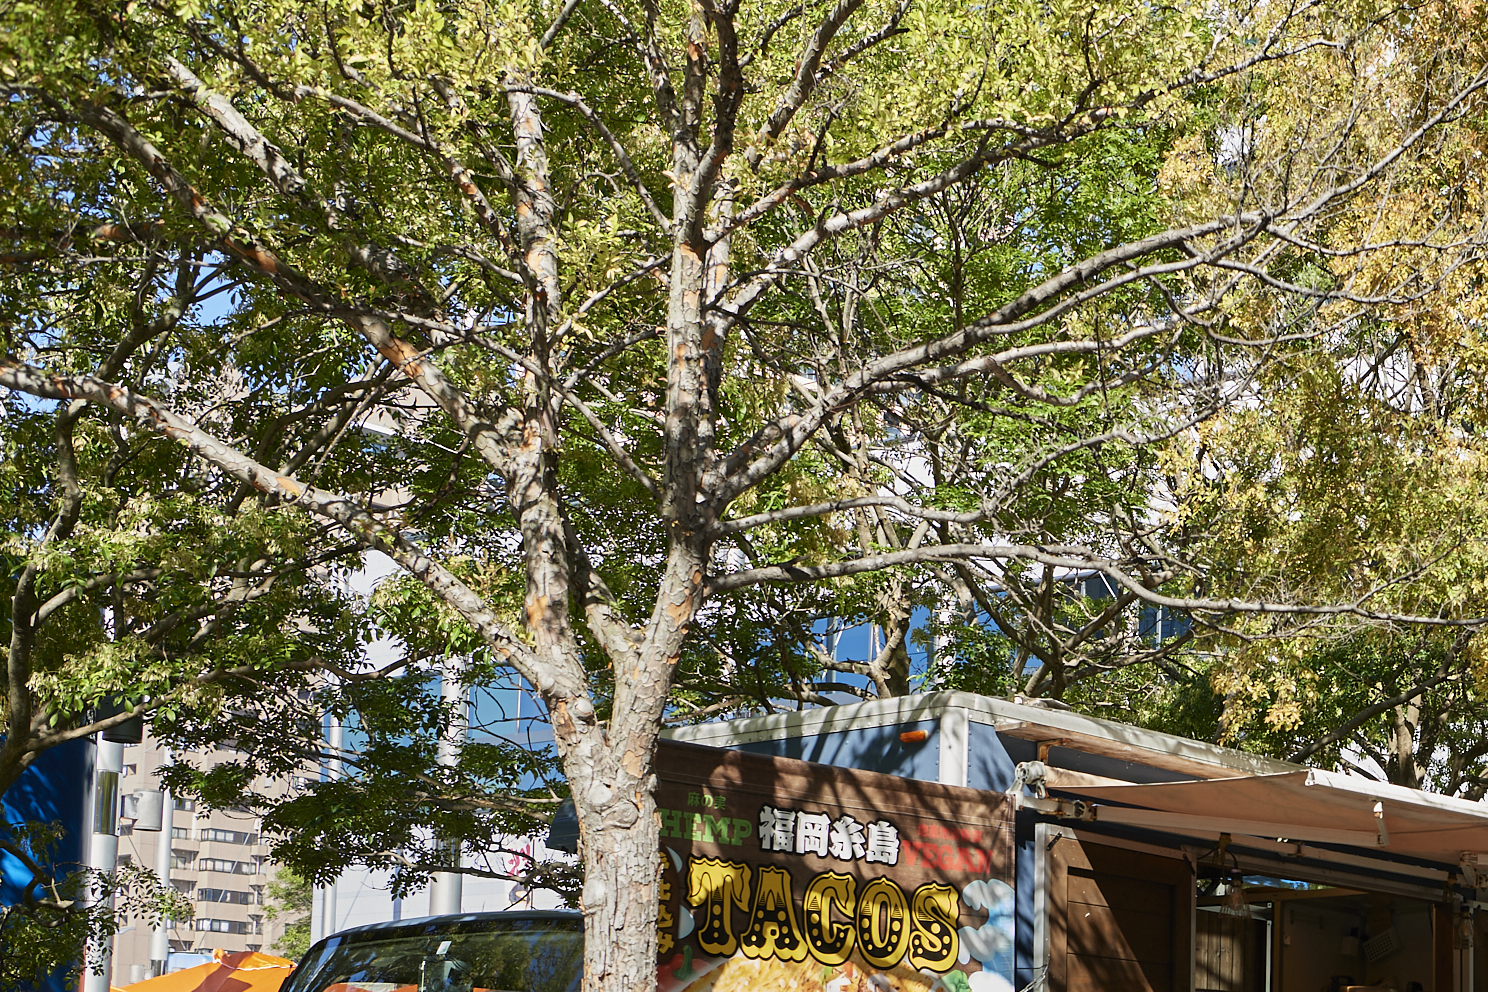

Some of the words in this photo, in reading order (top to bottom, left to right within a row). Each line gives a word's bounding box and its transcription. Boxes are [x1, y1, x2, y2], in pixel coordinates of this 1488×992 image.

[687, 791, 727, 811] 麻の実
[659, 807, 753, 846] HEMP
[756, 804, 902, 866] 福岡糸島
[901, 839, 994, 875] VEGAN
[686, 855, 961, 975] TACOS
